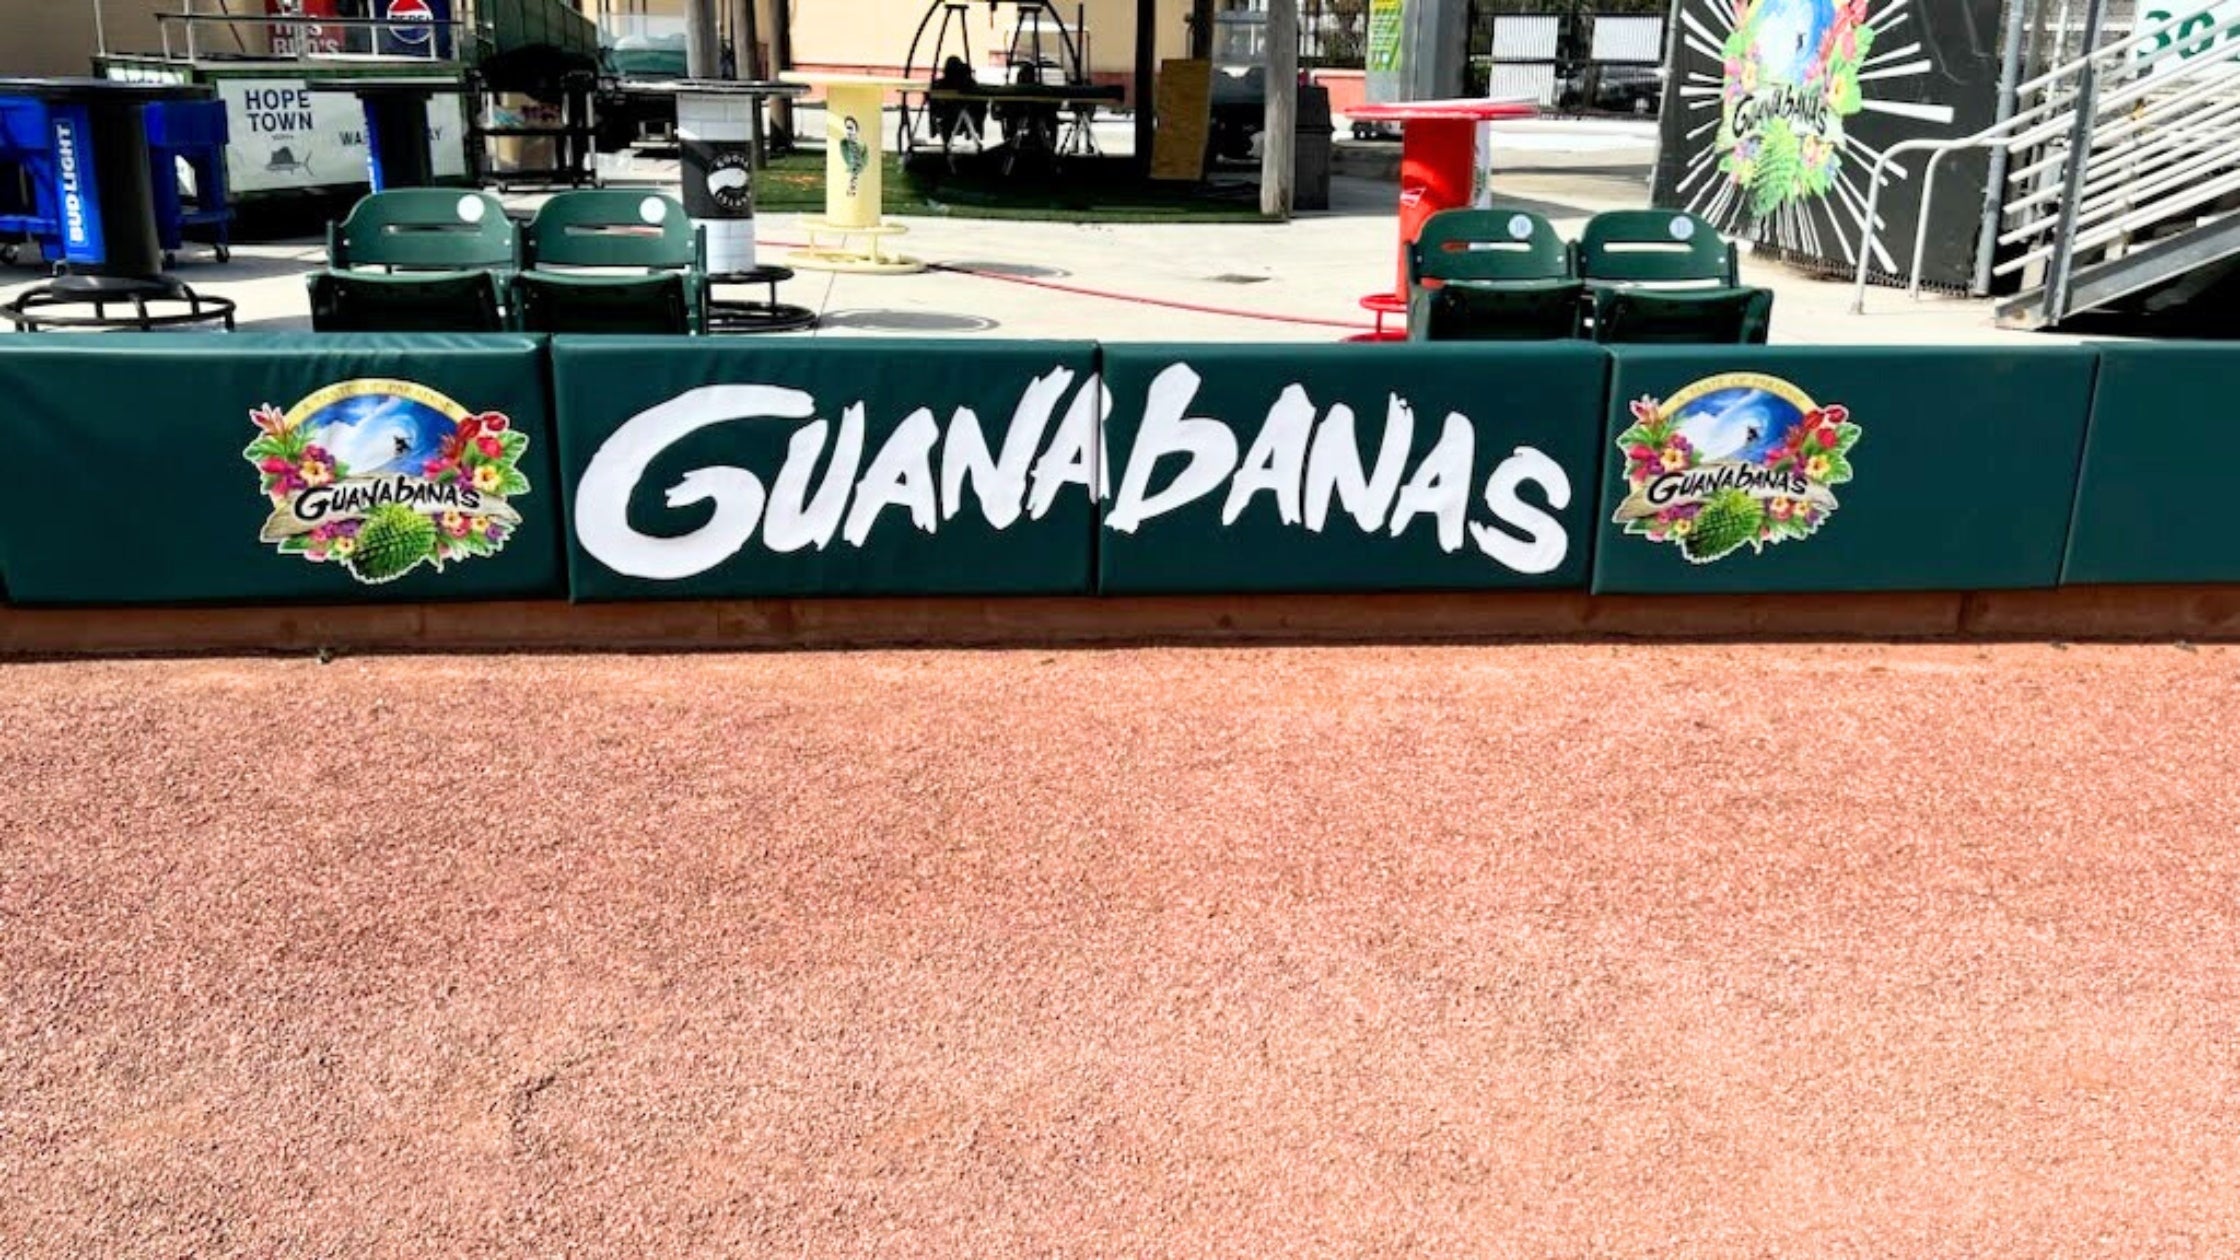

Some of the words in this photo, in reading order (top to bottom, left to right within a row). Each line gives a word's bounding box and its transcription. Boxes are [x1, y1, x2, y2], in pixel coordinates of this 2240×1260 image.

[245, 89, 311, 110] HOPE
[246, 111, 313, 132] TOWN
[56, 123, 78, 191] LIGHT
[65, 193, 85, 242] BUD
